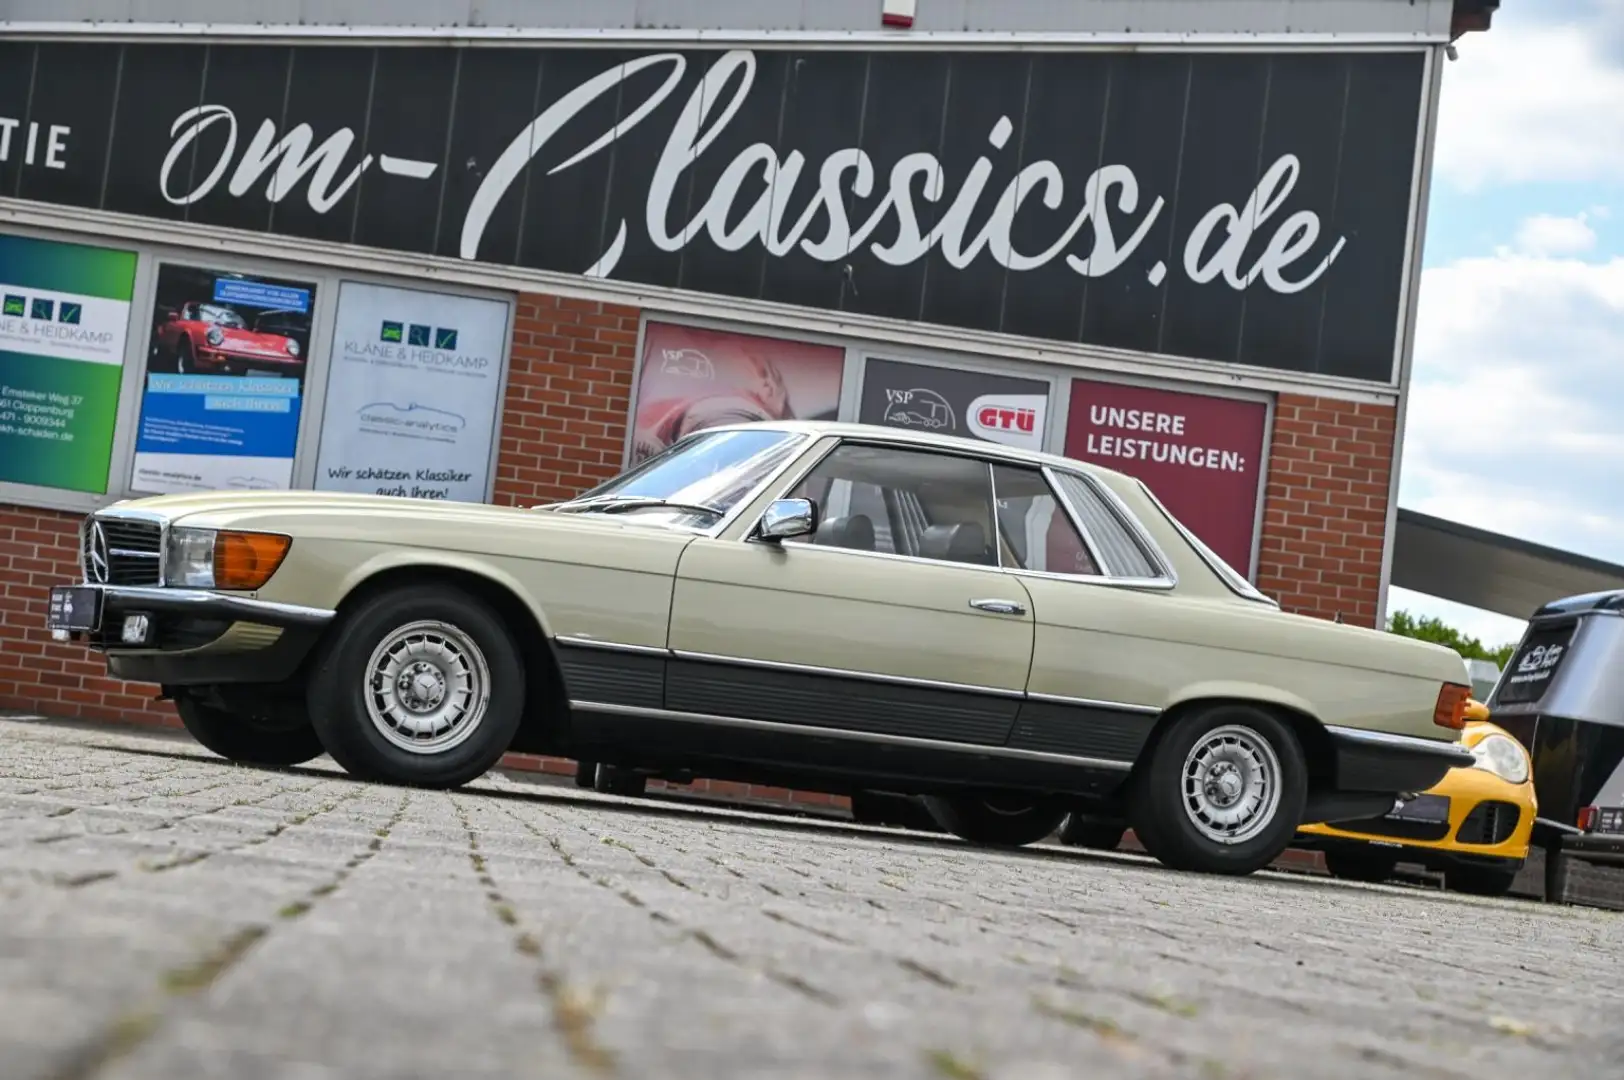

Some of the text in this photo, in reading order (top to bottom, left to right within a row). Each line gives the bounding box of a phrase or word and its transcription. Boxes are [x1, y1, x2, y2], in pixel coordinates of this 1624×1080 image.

[34, 322, 113, 343] HEIDKAMP
[397, 349, 407, 360] &
[411, 351, 488, 369] HEIDKAMP
[885, 388, 914, 404] VSP
[12, 400, 74, 419] Cloppenburg
[979, 407, 1036, 432] GTÜ
[1090, 404, 1186, 436] UNSERE
[1087, 433, 1245, 472] LEISTUNGEN:
[328, 467, 352, 479] Wir
[415, 468, 472, 482] Klassiker
[411, 486, 449, 499] Ihren!
